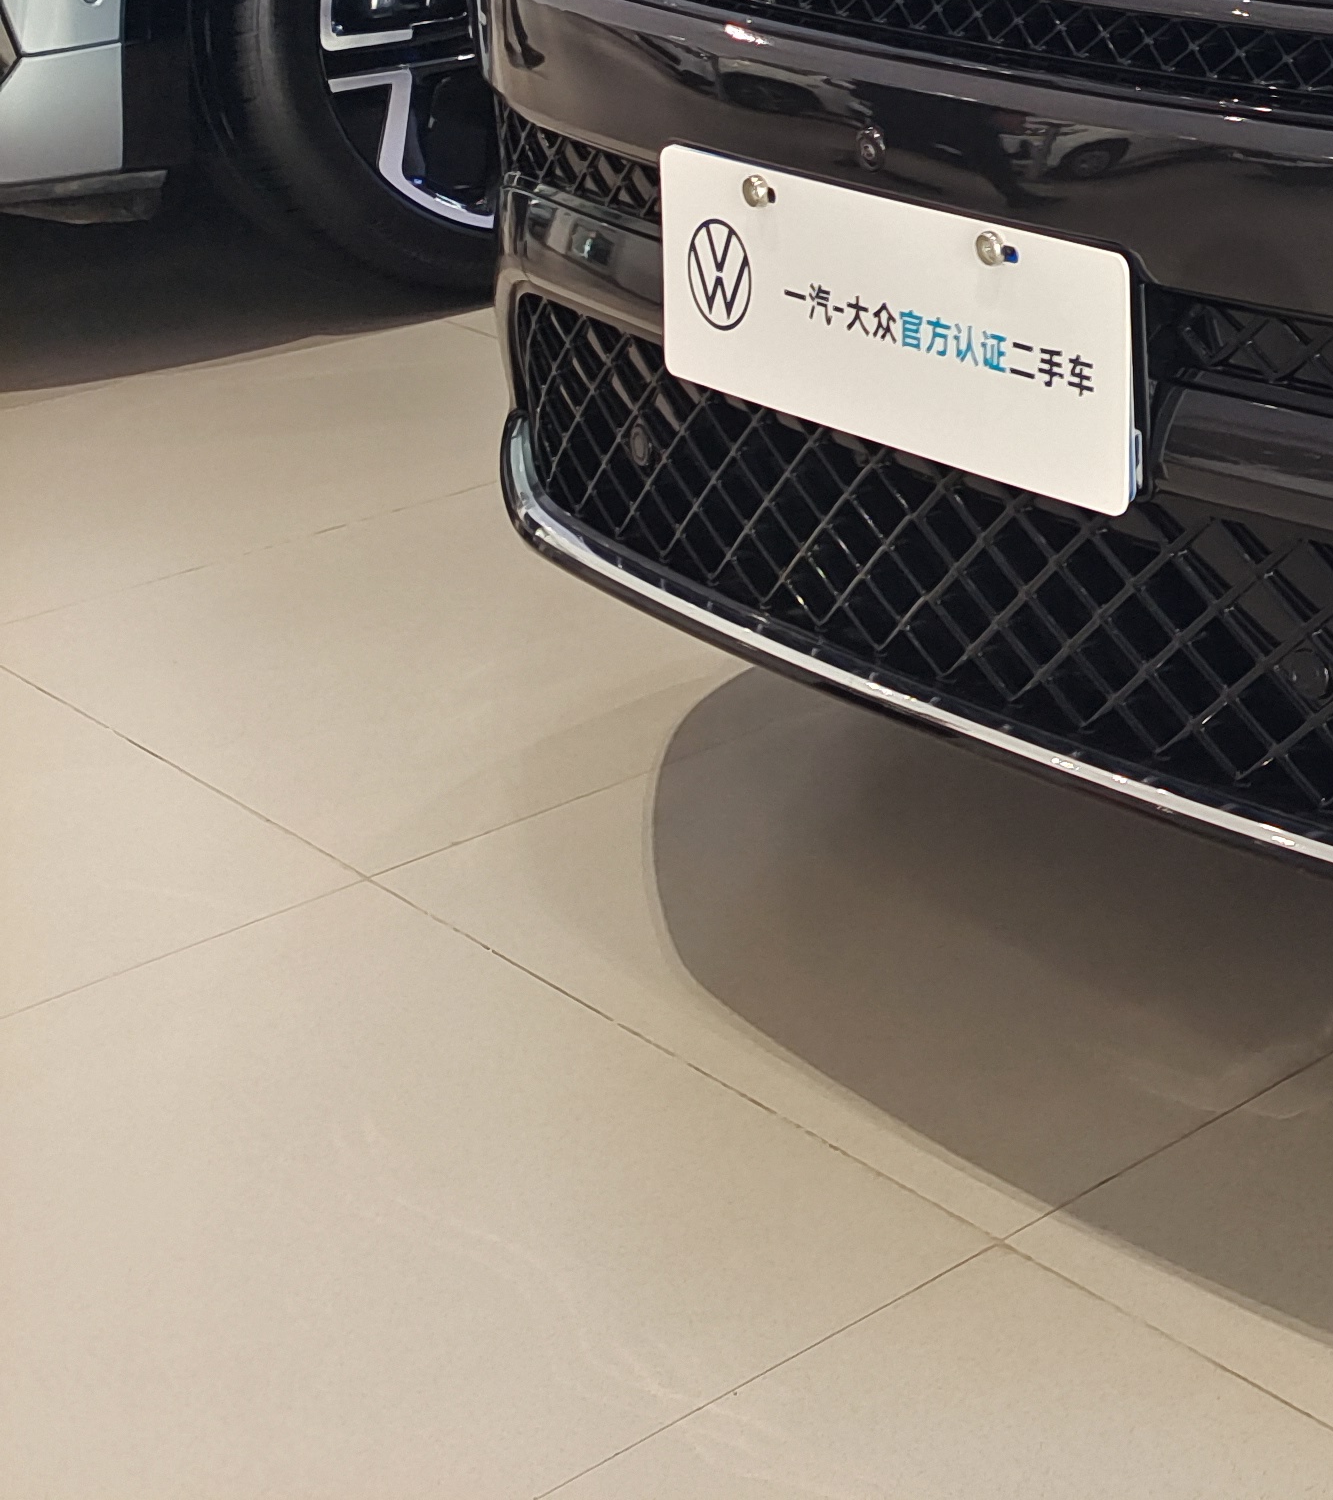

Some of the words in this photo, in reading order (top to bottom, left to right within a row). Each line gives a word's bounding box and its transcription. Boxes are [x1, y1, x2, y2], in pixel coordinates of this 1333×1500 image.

[688, 218, 752, 331] VW
[783, 282, 1095, 397] 一汽-大众官方认证二手车
